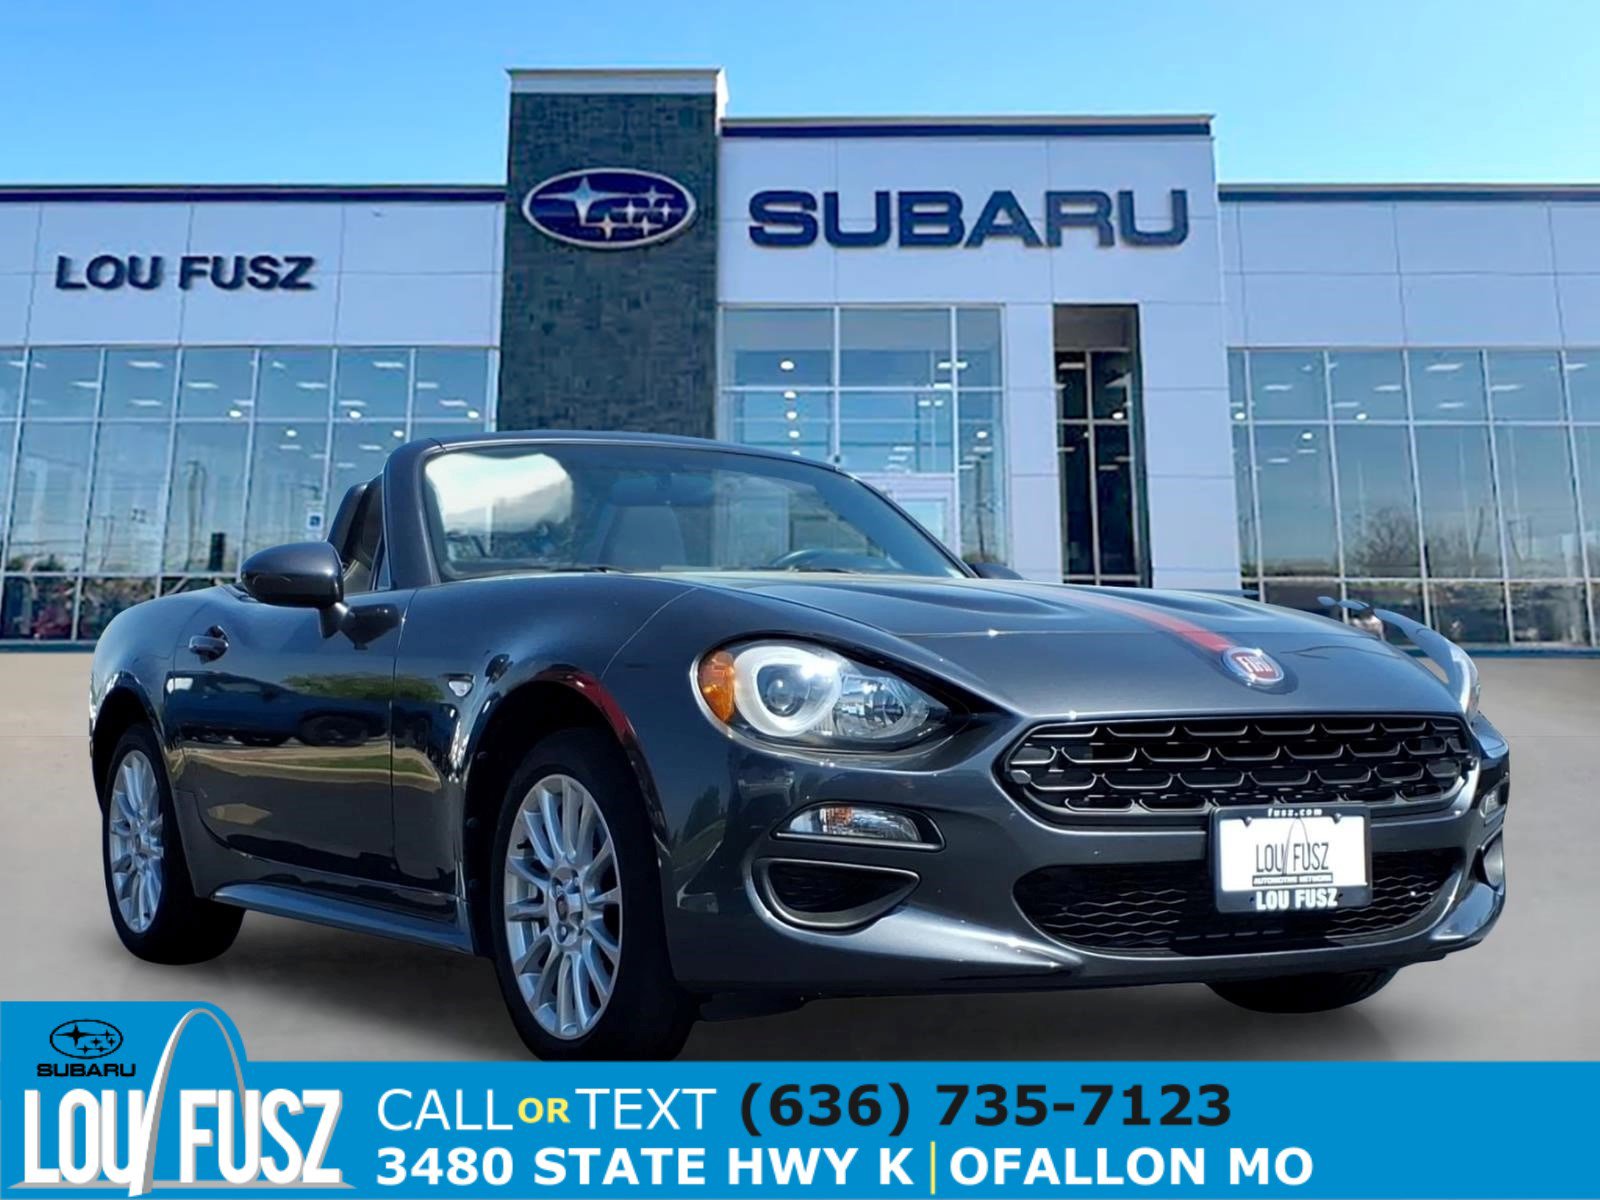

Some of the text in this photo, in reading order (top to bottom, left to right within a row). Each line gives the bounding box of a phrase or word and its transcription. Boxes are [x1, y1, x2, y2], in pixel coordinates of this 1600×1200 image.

[749, 189, 1190, 248] SUBARU
[55, 254, 318, 290] LOU FUSZ
[1267, 808, 1322, 816] fusz.com
[1256, 842, 1329, 872] LOU FUSZ
[1256, 888, 1339, 911] LOU FUSZ
